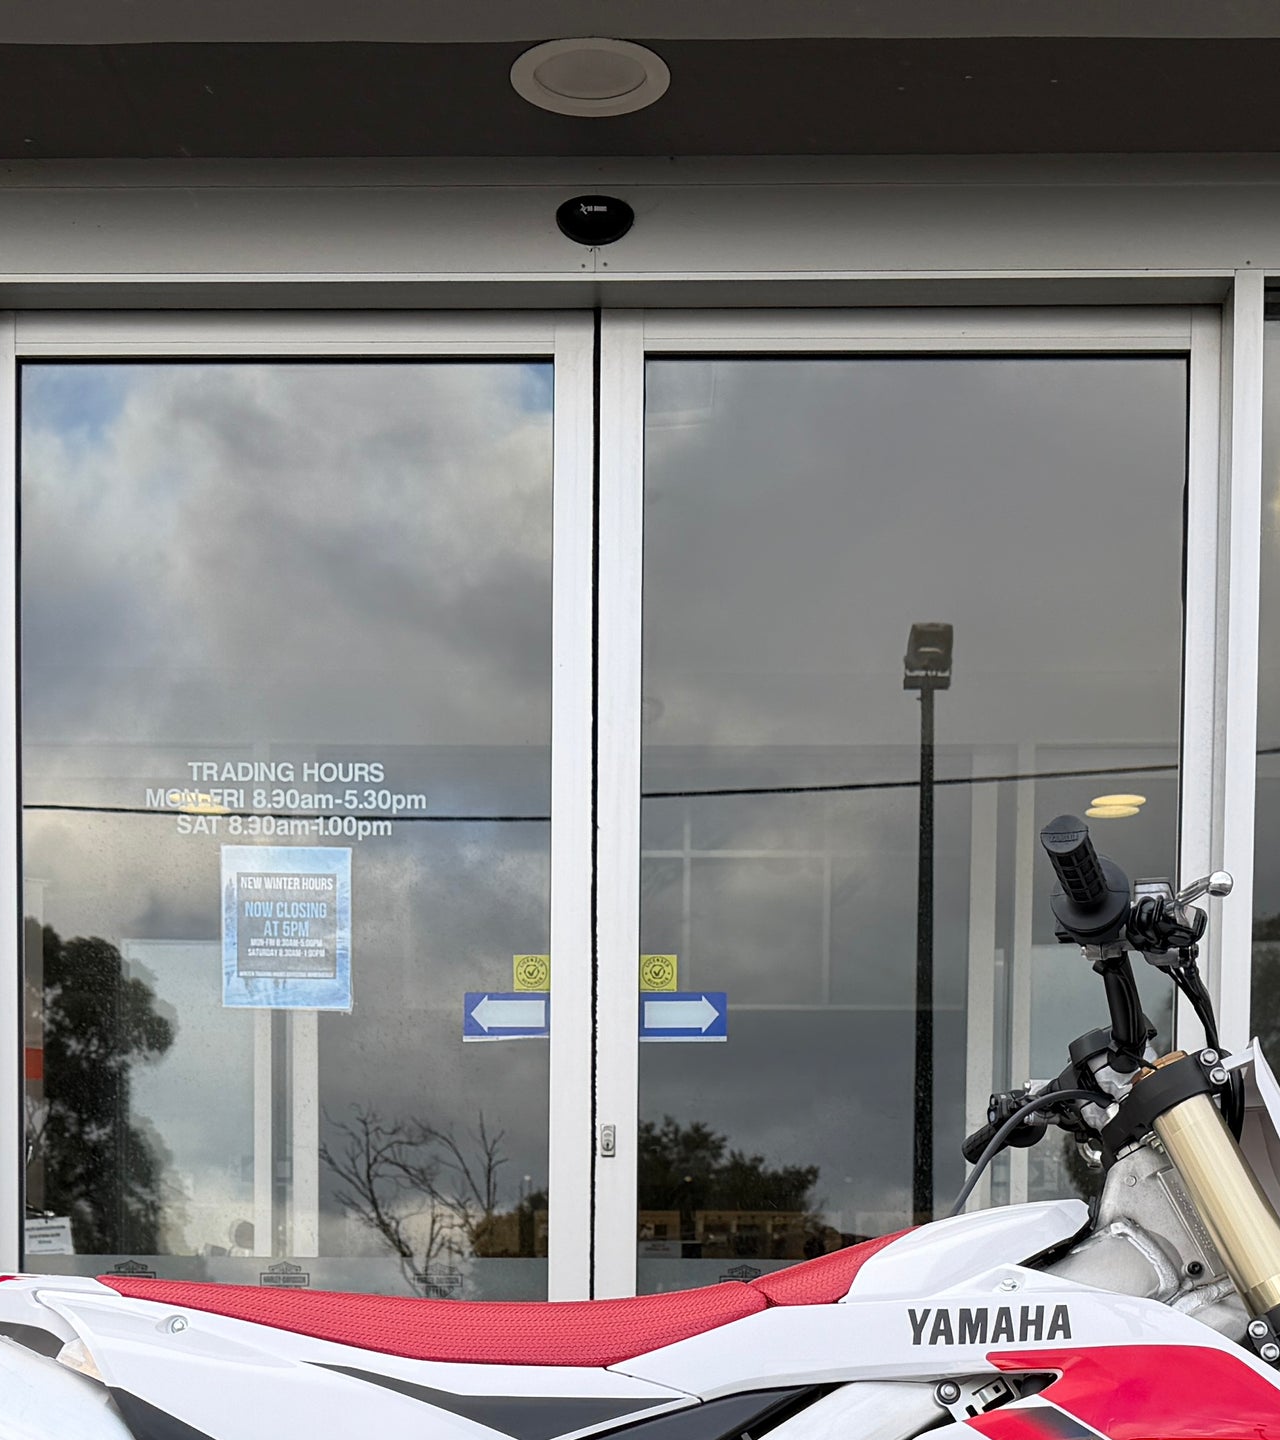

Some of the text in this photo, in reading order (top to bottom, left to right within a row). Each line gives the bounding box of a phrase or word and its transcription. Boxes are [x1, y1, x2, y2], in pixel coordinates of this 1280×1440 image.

[188, 762, 385, 783] TRADING HOURS
[176, 815, 222, 835] SAT
[241, 876, 333, 890] NEW WINTER HOURS
[245, 901, 327, 919] NOW CLOSING
[264, 920, 310, 937] AT 5PM
[907, 1304, 1072, 1346] YAMAHA
